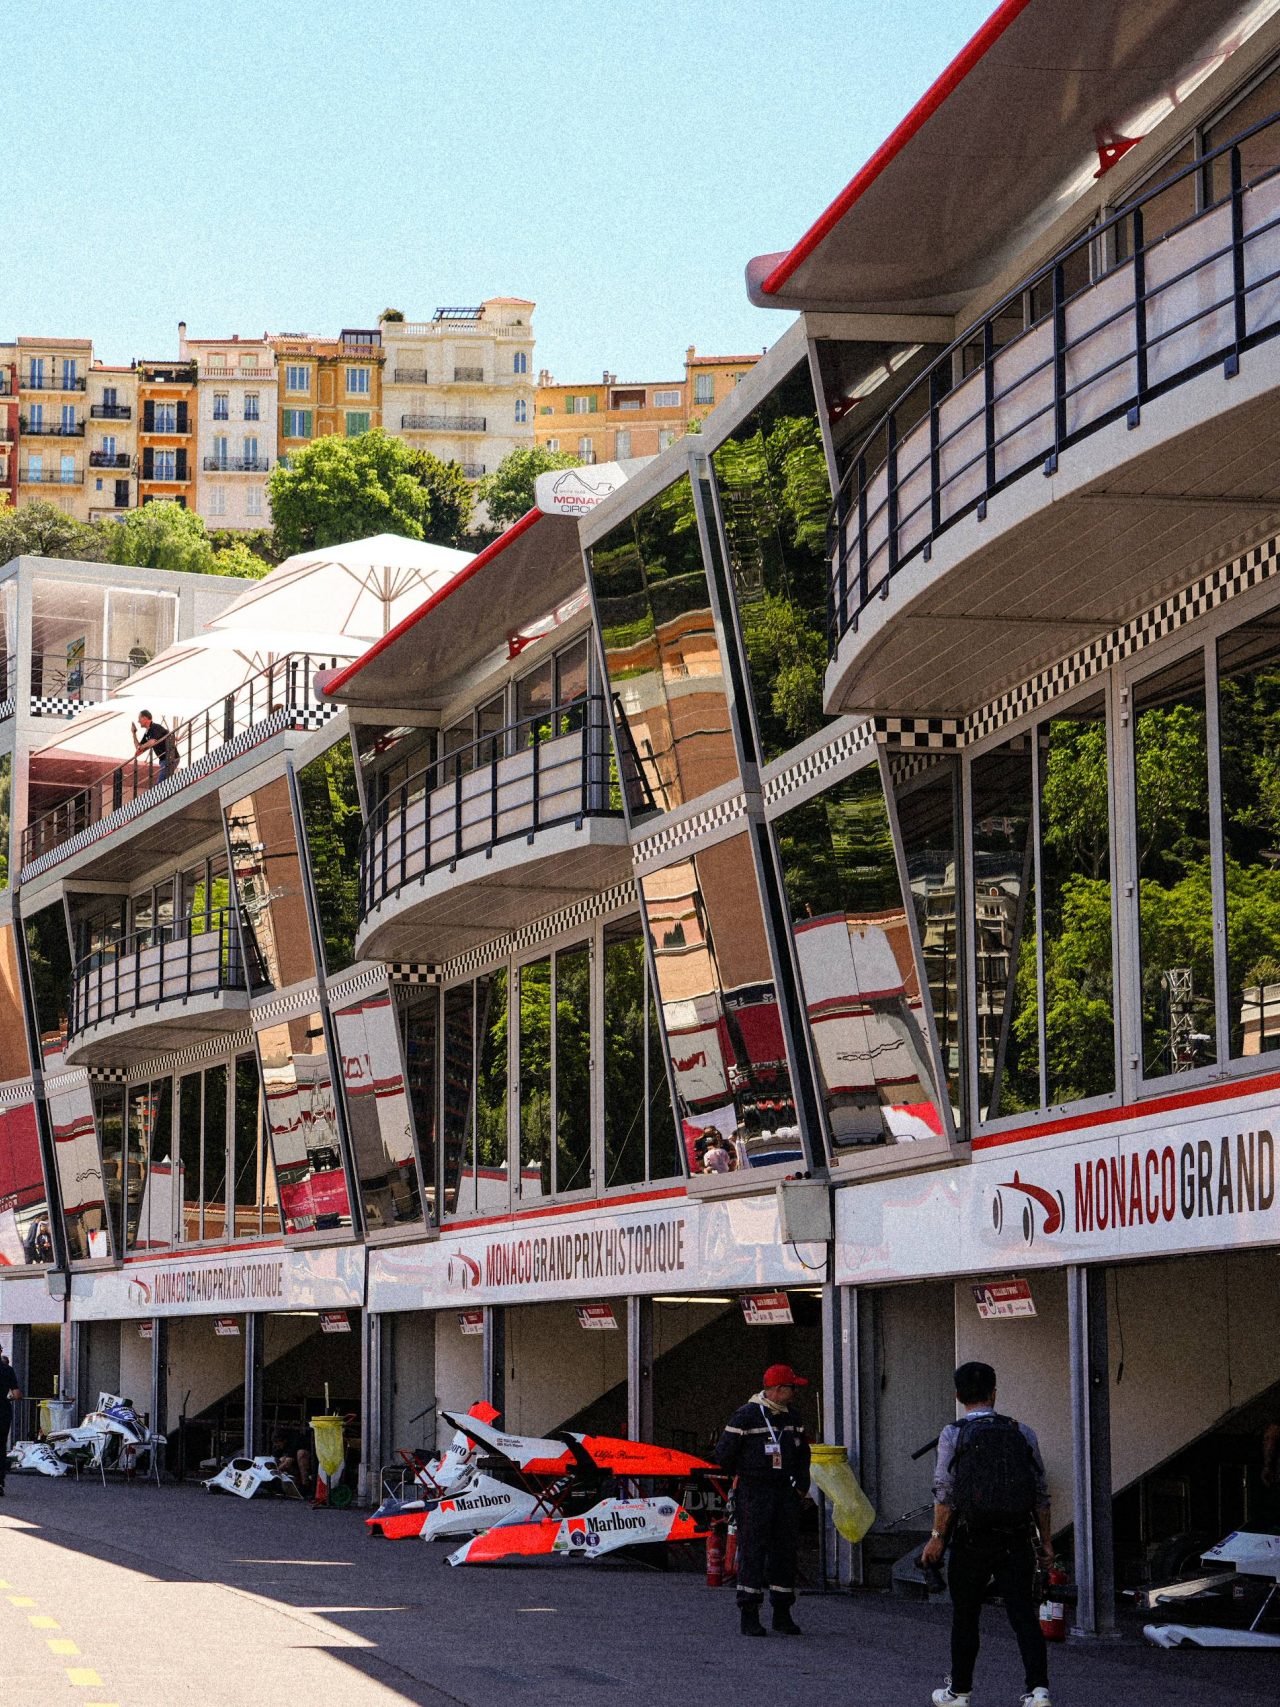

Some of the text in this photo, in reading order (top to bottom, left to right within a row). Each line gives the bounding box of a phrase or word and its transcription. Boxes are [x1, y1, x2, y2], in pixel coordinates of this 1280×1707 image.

[561, 504, 591, 514] CIRC
[1074, 1129, 1275, 1233] MONACO GRAND
[455, 1493, 511, 1512] Marlboro
[587, 1511, 646, 1533] Marlboro
